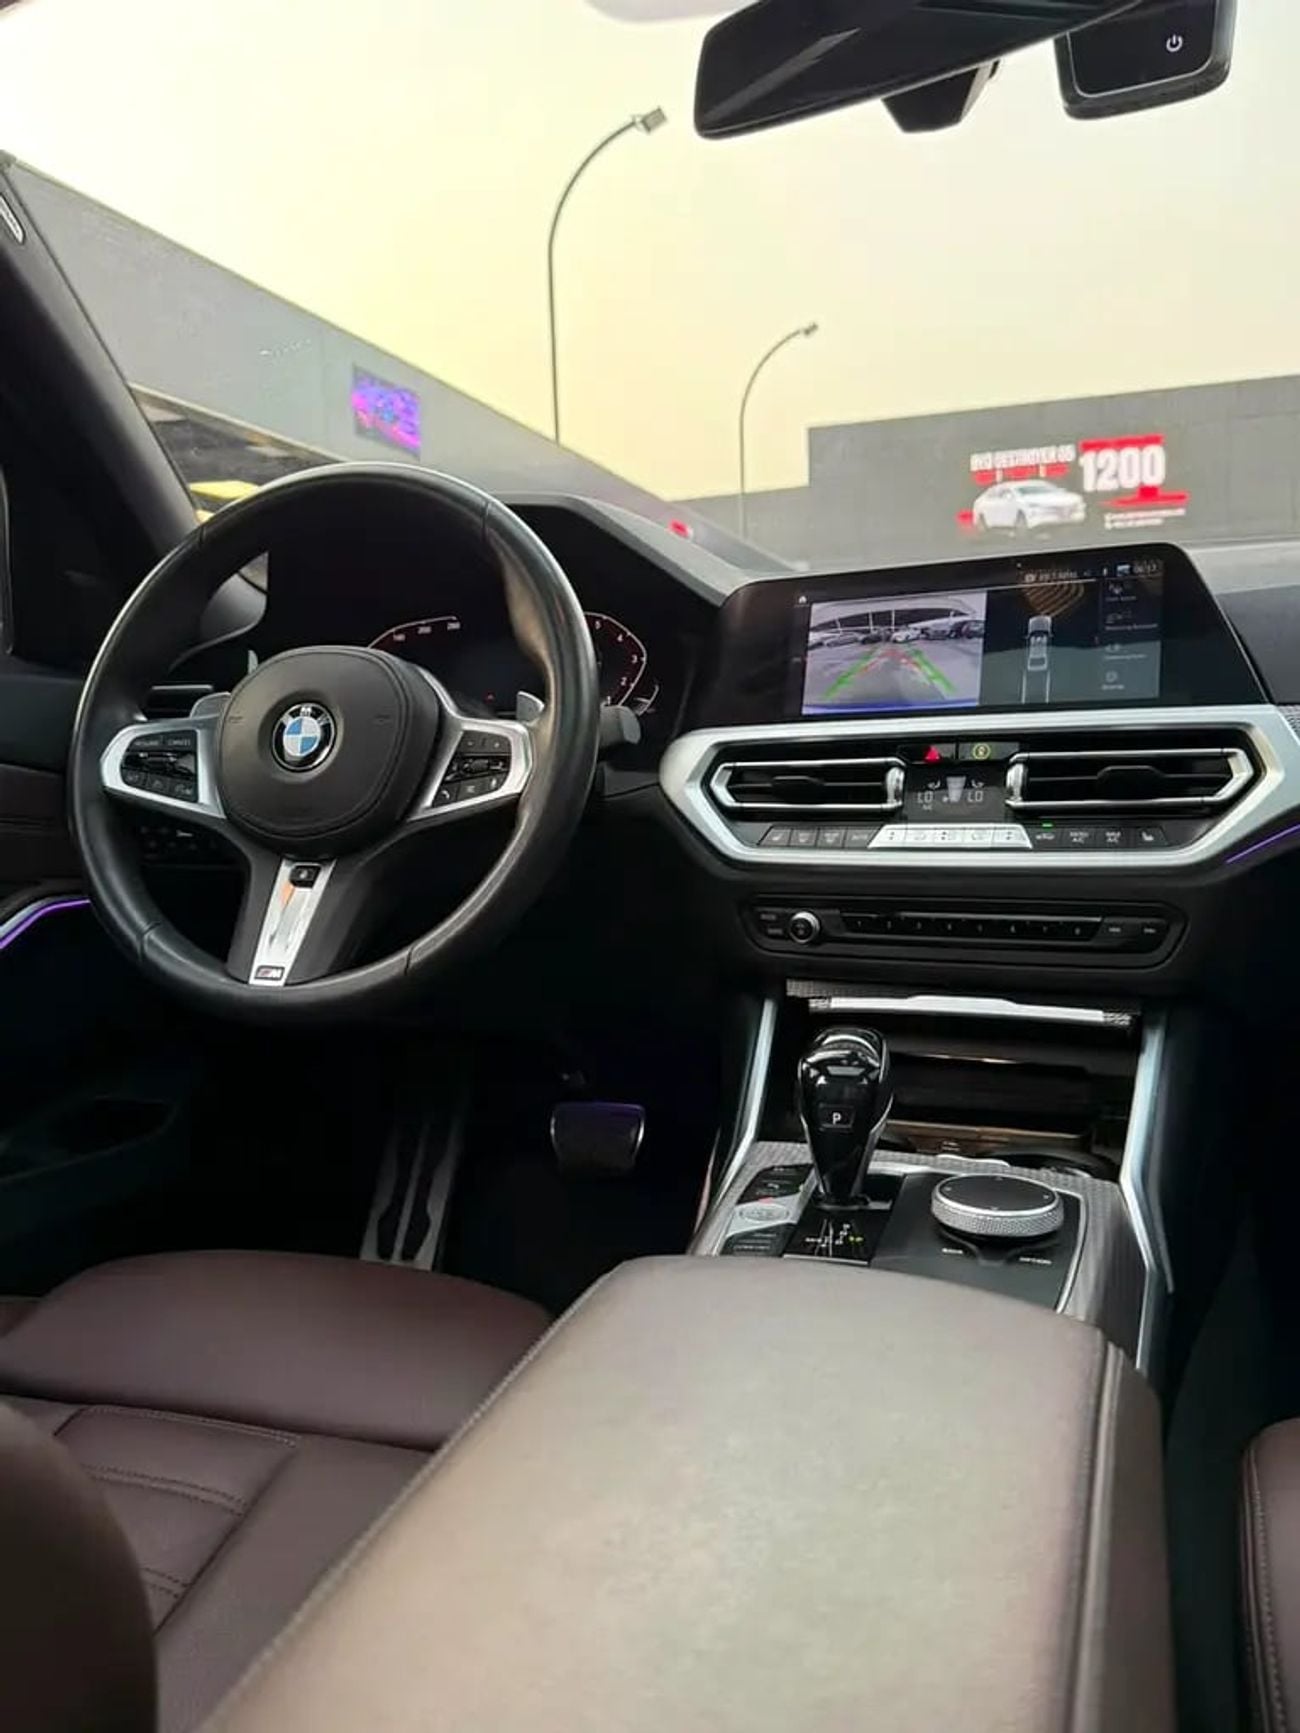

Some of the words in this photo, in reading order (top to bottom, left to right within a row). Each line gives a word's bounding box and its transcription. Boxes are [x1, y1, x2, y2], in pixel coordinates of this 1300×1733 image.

[1078, 444, 1165, 492] 1200
[631, 654, 638, 664] 3
[832, 1112, 842, 1125] P
